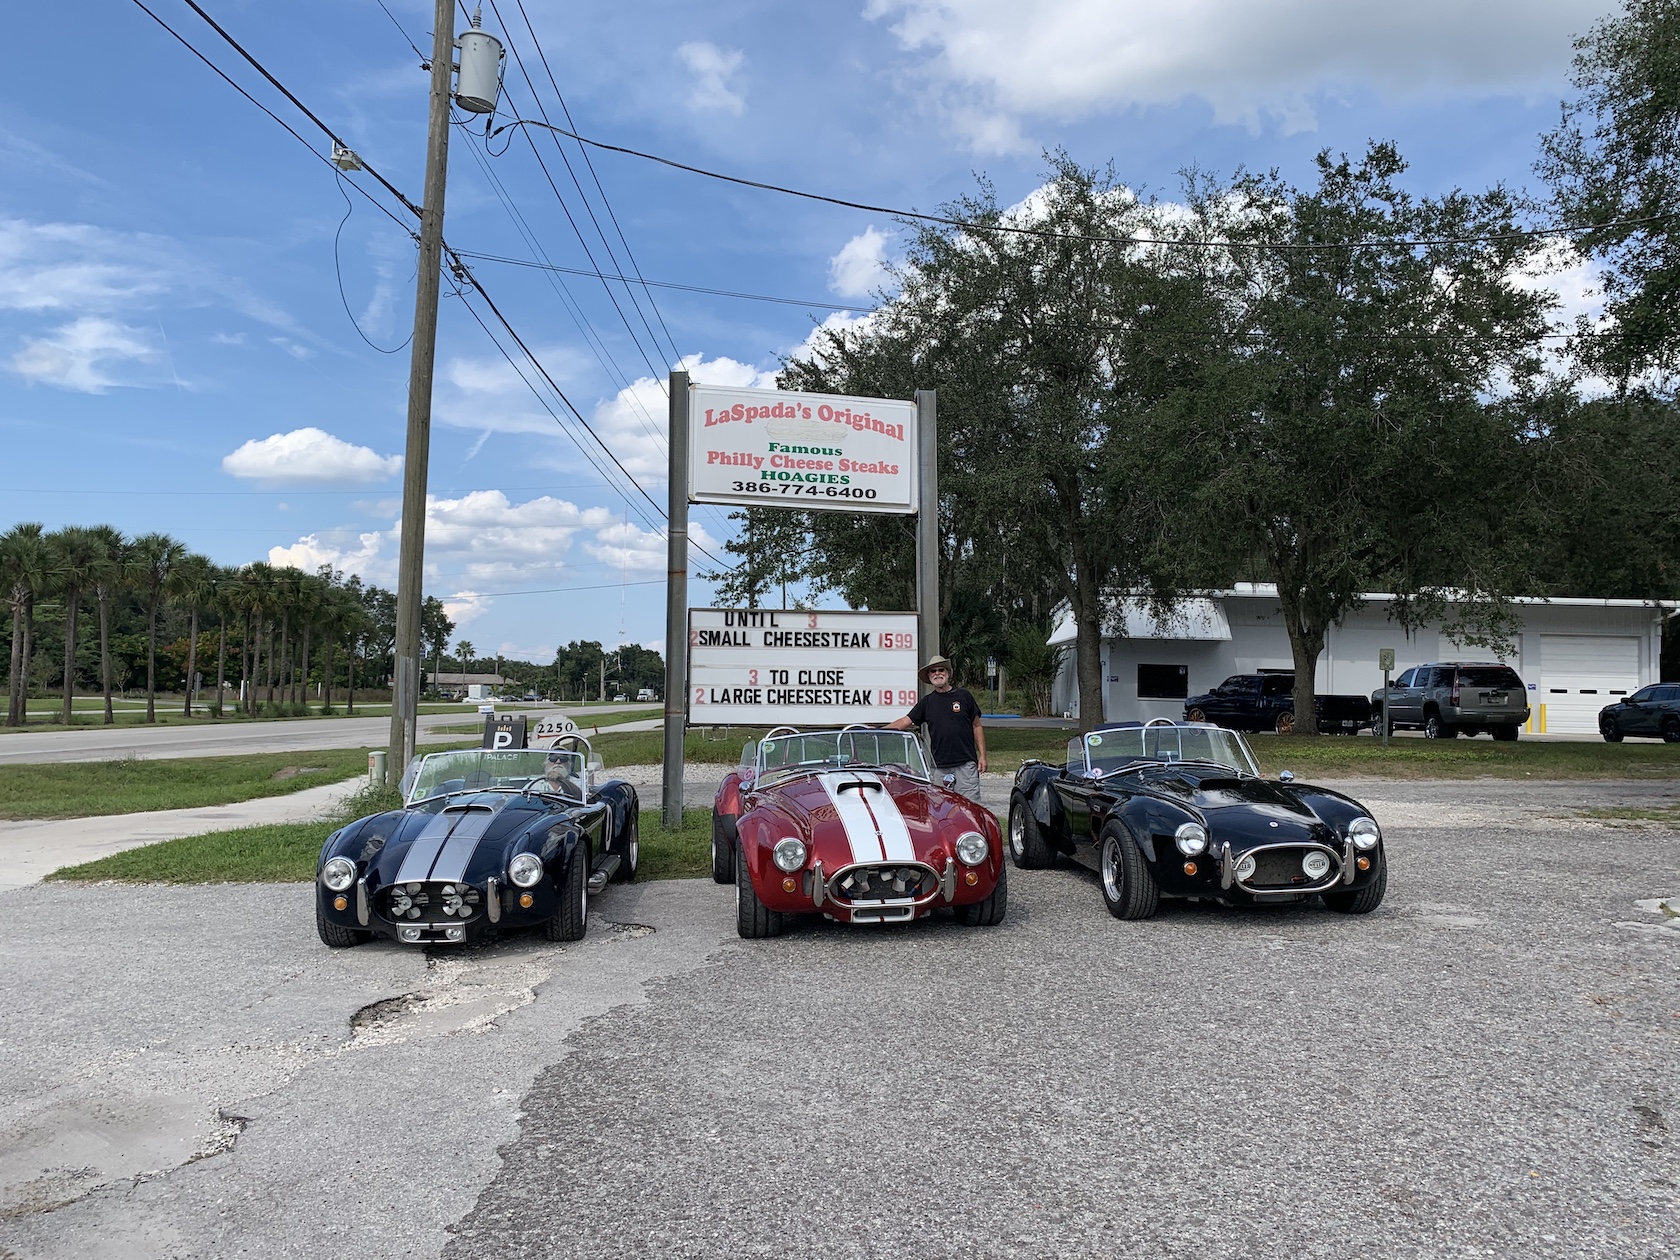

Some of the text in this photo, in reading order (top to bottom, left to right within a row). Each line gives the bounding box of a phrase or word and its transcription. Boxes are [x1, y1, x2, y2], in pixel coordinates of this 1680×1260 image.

[704, 402, 905, 442] LaSpada's Original
[768, 442, 843, 456] Famous
[706, 450, 899, 475] Philly Cheese Steaks
[760, 470, 850, 485] HOAGIES
[731, 481, 877, 499] 386-774-6400
[724, 612, 817, 628] UNTIL 3
[763, 631, 870, 648] CHEESESTEAK
[878, 633, 913, 649] 1599
[748, 669, 844, 686] 3 TO CLOSE
[695, 688, 705, 704] 2
[710, 688, 762, 704] LARGE
[767, 689, 872, 705] CHEESESTEAK
[538, 722, 573, 734] 2250
[493, 731, 512, 750] P
